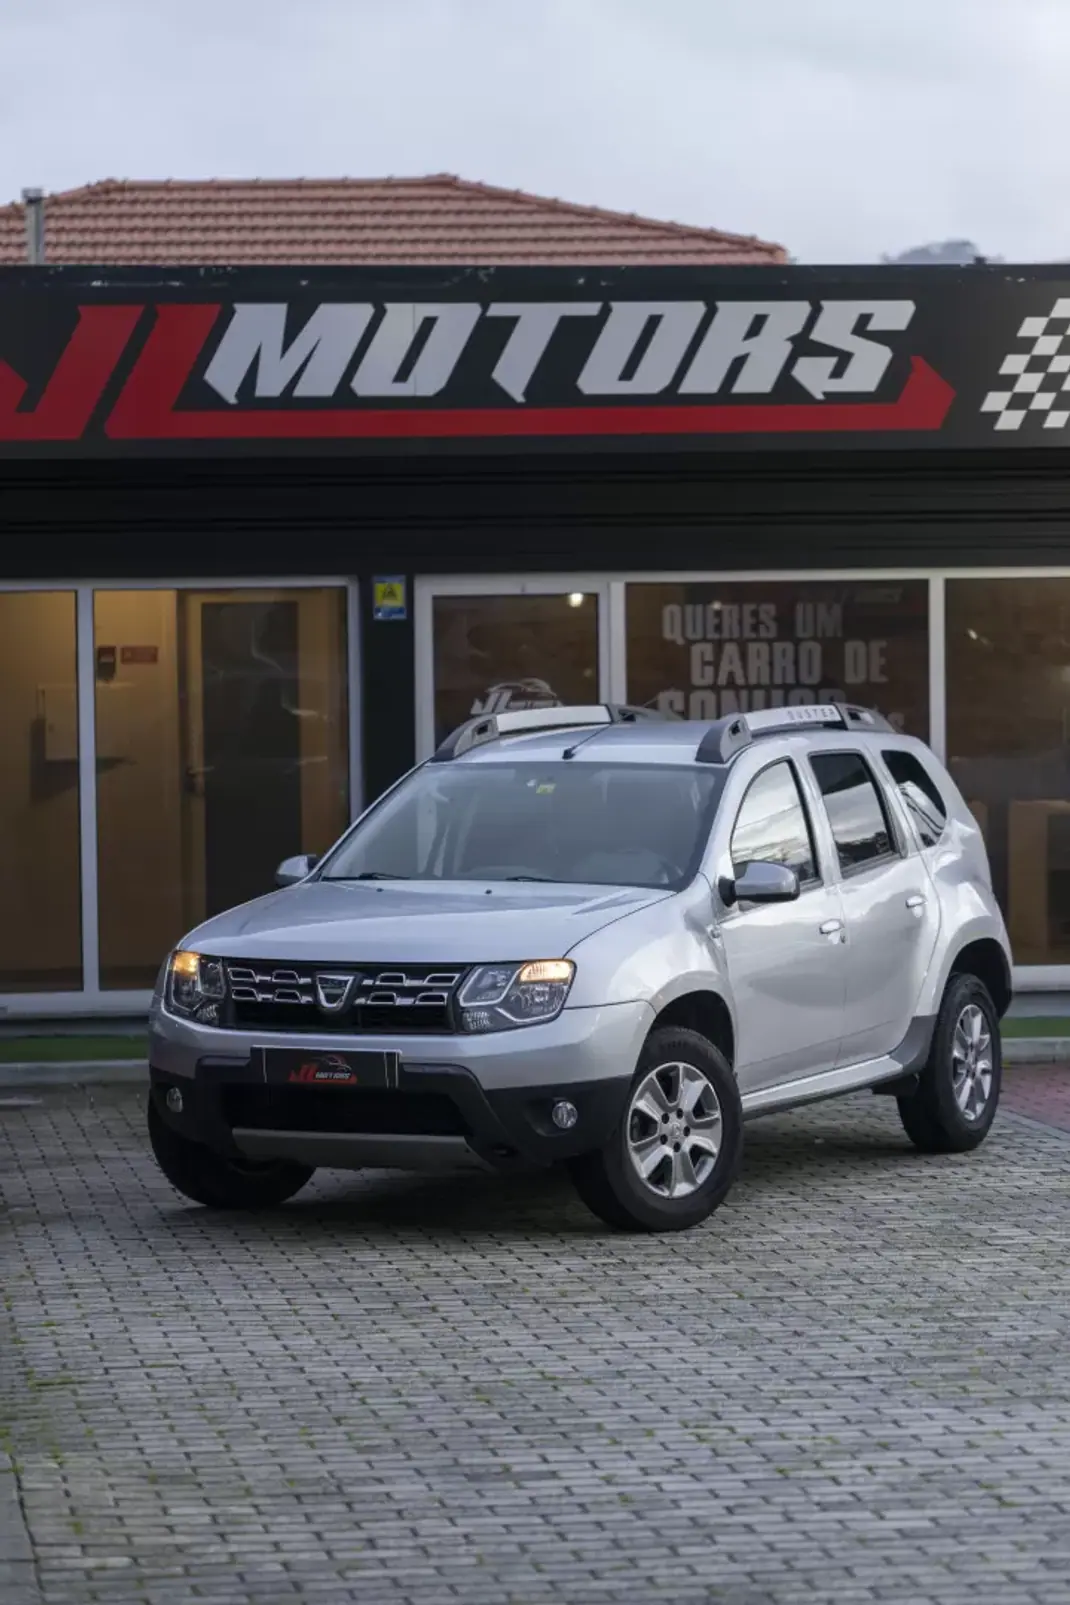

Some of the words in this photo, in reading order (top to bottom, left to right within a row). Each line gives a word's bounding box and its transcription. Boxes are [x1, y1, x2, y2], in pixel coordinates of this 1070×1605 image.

[203, 299, 916, 405] MOTORS
[662, 603, 778, 645] QUERES
[795, 603, 843, 638] UM
[690, 640, 822, 686] CARRO
[844, 640, 888, 684] DE
